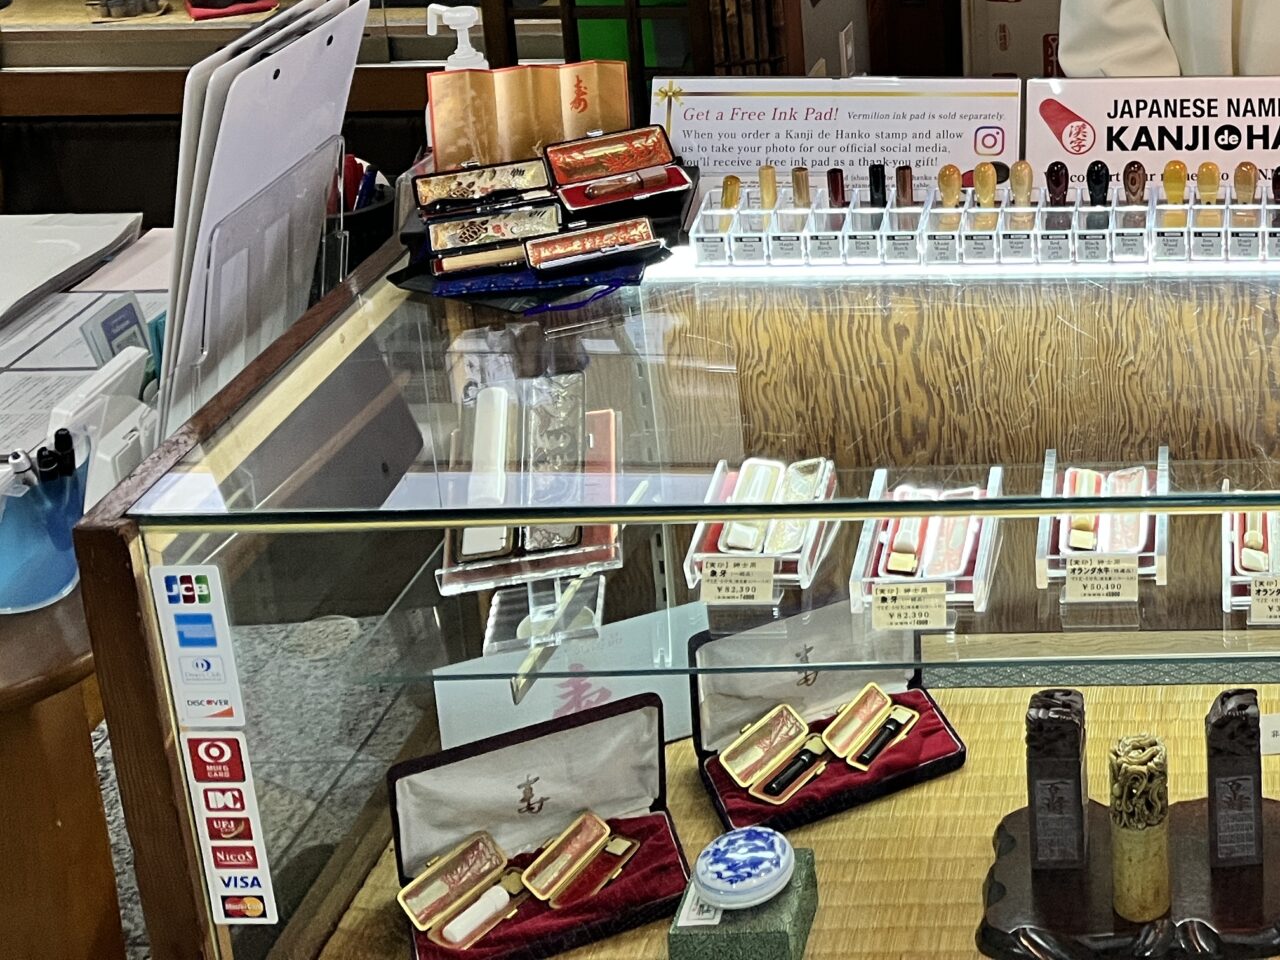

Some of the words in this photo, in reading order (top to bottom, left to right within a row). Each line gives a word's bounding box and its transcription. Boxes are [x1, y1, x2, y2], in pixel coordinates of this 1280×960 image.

[570, 74, 589, 114] 寿
[683, 107, 710, 121] Get
[715, 111, 724, 121] a
[730, 107, 766, 121] Free
[771, 107, 798, 121] Ink
[804, 107, 839, 121] Pad!
[1107, 98, 1218, 119] JAPANESE
[847, 112, 890, 120] Vermilion
[892, 112, 907, 120] ink
[909, 112, 926, 121] pad
[928, 112, 936, 120] is
[938, 112, 957, 120] sold
[682, 130, 713, 140] When
[717, 132, 737, 141] you
[741, 129, 771, 140] order
[774, 132, 780, 140] a
[785, 129, 813, 141] Kanji
[817, 129, 831, 140] de
[835, 129, 871, 140] Hanko
[875, 130, 908, 141] stamp
[911, 129, 931, 140] and
[936, 129, 964, 140] allow
[1069, 123, 1087, 152] 漢字
[1106, 125, 1210, 151] KANJI
[1217, 129, 1239, 146] de
[681, 145, 694, 153] us
[697, 144, 708, 153] to
[711, 143, 734, 153] take
[737, 145, 762, 155] your
[765, 143, 796, 155] photo
[799, 143, 813, 153] for
[817, 145, 836, 153] our
[839, 143, 877, 153] official
[880, 143, 911, 153] social
[915, 143, 950, 153] media,
[713, 157, 752, 167] receive
[755, 159, 761, 167] a
[765, 157, 787, 167] free
[790, 157, 807, 167] ink
[811, 157, 830, 168] pad
[834, 159, 845, 167] as
[849, 159, 855, 167] a
[915, 157, 938, 168] gift!
[165, 580, 210, 598] JCB
[717, 586, 757, 594] ¥82,390
[187, 699, 229, 707] DISCOVER
[207, 790, 241, 809] DC
[213, 819, 235, 829] UFJ
[220, 875, 262, 888] VISA
